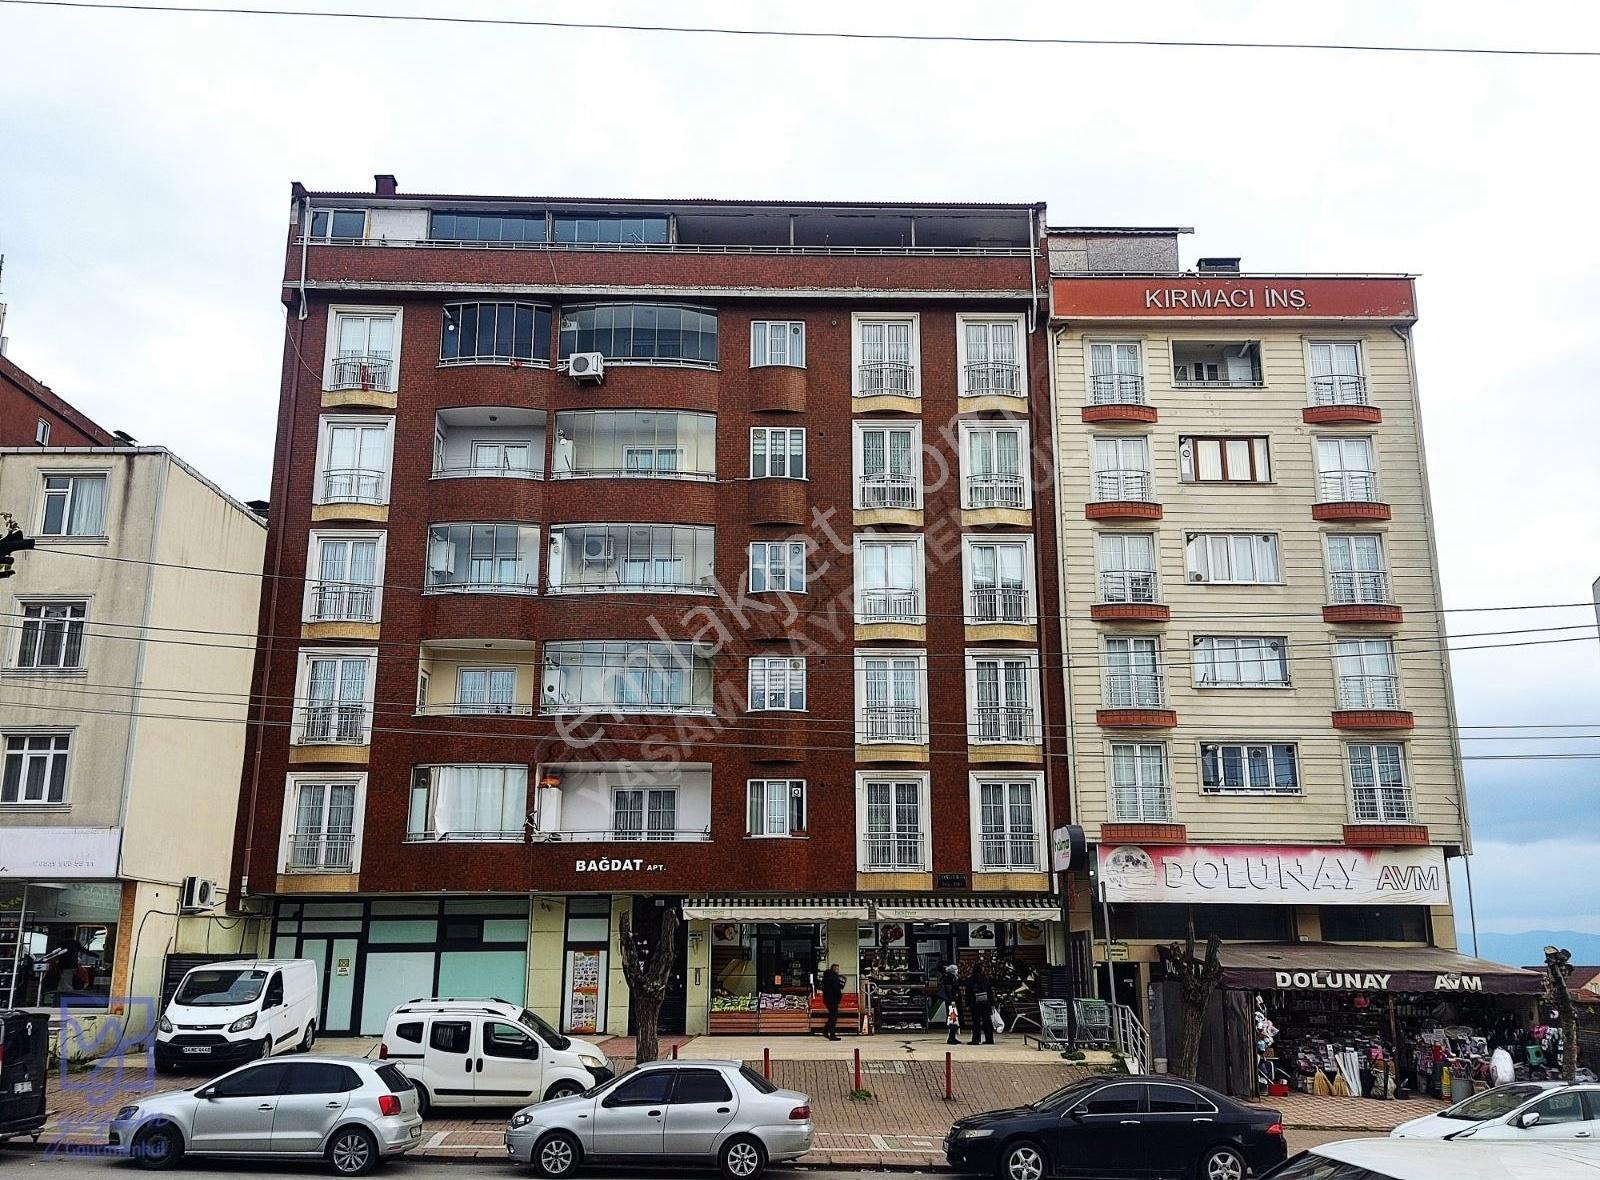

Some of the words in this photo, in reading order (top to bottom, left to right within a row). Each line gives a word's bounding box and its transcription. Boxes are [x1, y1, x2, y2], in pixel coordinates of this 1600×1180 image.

[1145, 289, 1255, 309] KIRMACI
[1265, 286, 1312, 310] İNŞ.
[575, 856, 644, 872] BAĞDAT
[646, 864, 667, 872] APT.
[1161, 856, 1358, 891] DOLUNAY
[1376, 866, 1440, 891] AVM
[1275, 971, 1391, 990] DOLUNAY
[1434, 974, 1483, 991] AVM
